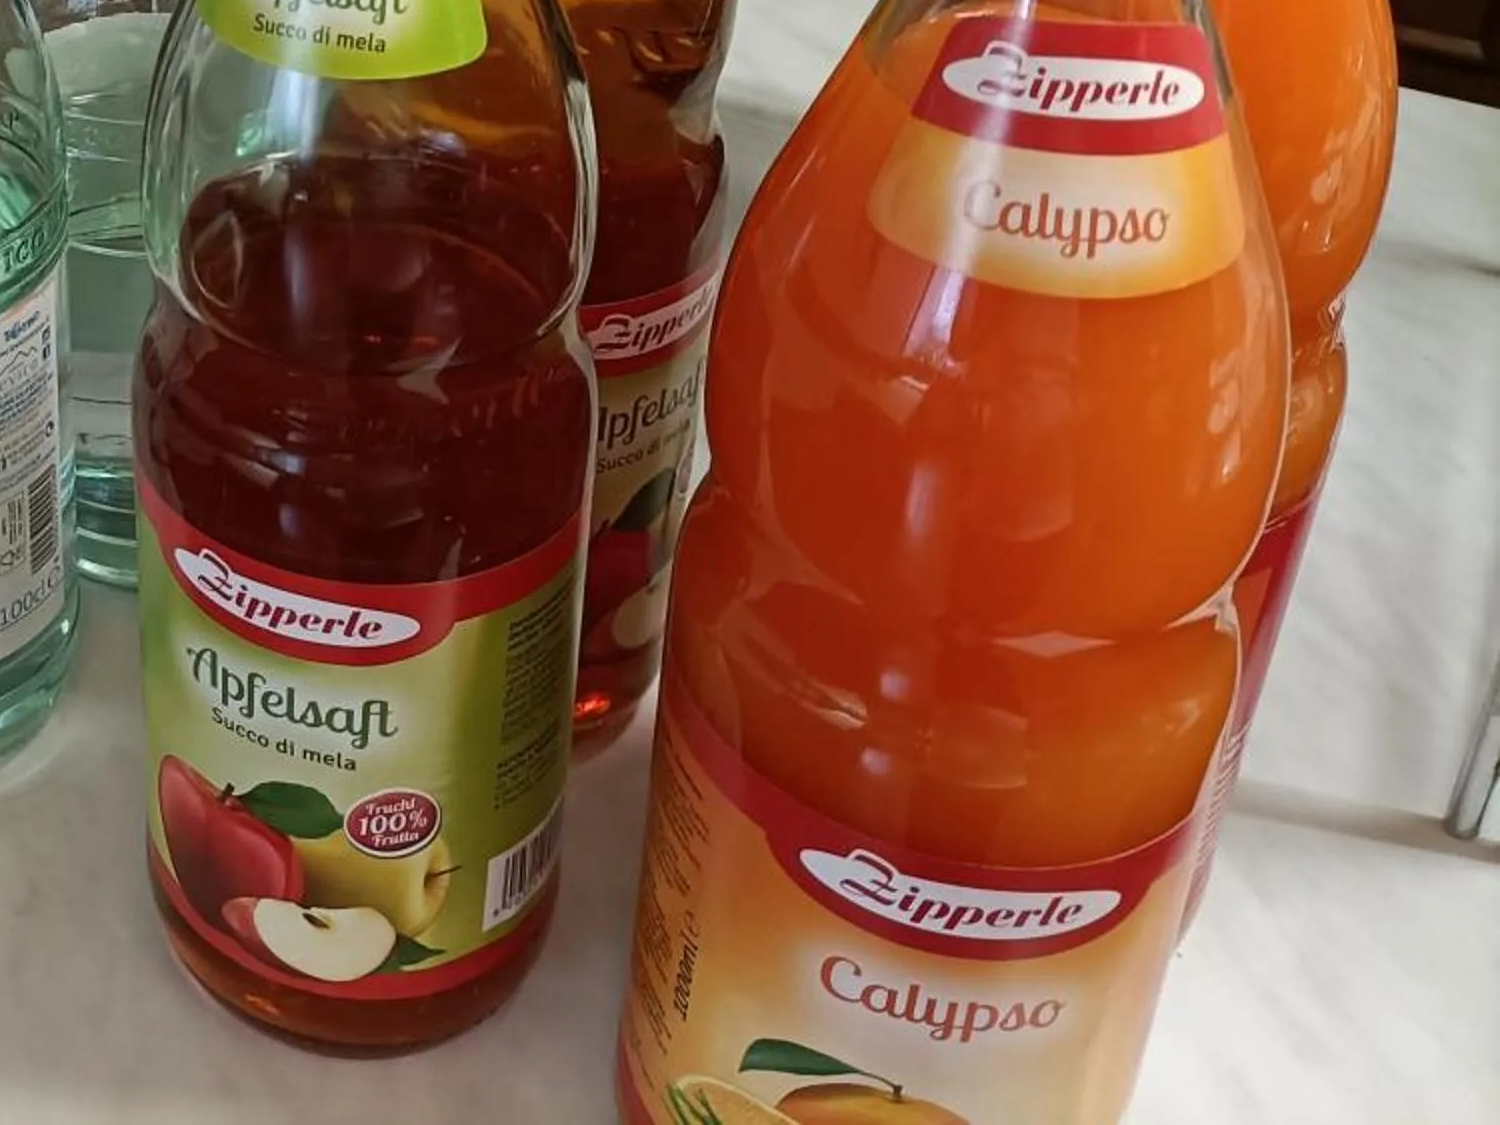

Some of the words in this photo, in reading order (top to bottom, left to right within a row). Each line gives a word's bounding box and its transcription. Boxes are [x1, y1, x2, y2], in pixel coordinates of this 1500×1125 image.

[252, 13, 308, 41] Succo
[312, 25, 331, 46] di
[336, 32, 386, 54] mela
[977, 45, 1181, 112] Zipperle
[963, 179, 1170, 260] Calypso
[597, 447, 644, 474] Succo
[197, 552, 383, 640] Zipperle
[186, 647, 399, 750] Apfelsaft
[211, 706, 269, 748] Succo
[275, 738, 295, 757] di
[302, 747, 357, 772] mela
[358, 807, 428, 836] 100%
[839, 853, 1083, 931] Zipperle
[820, 955, 1066, 1044] Calypso
